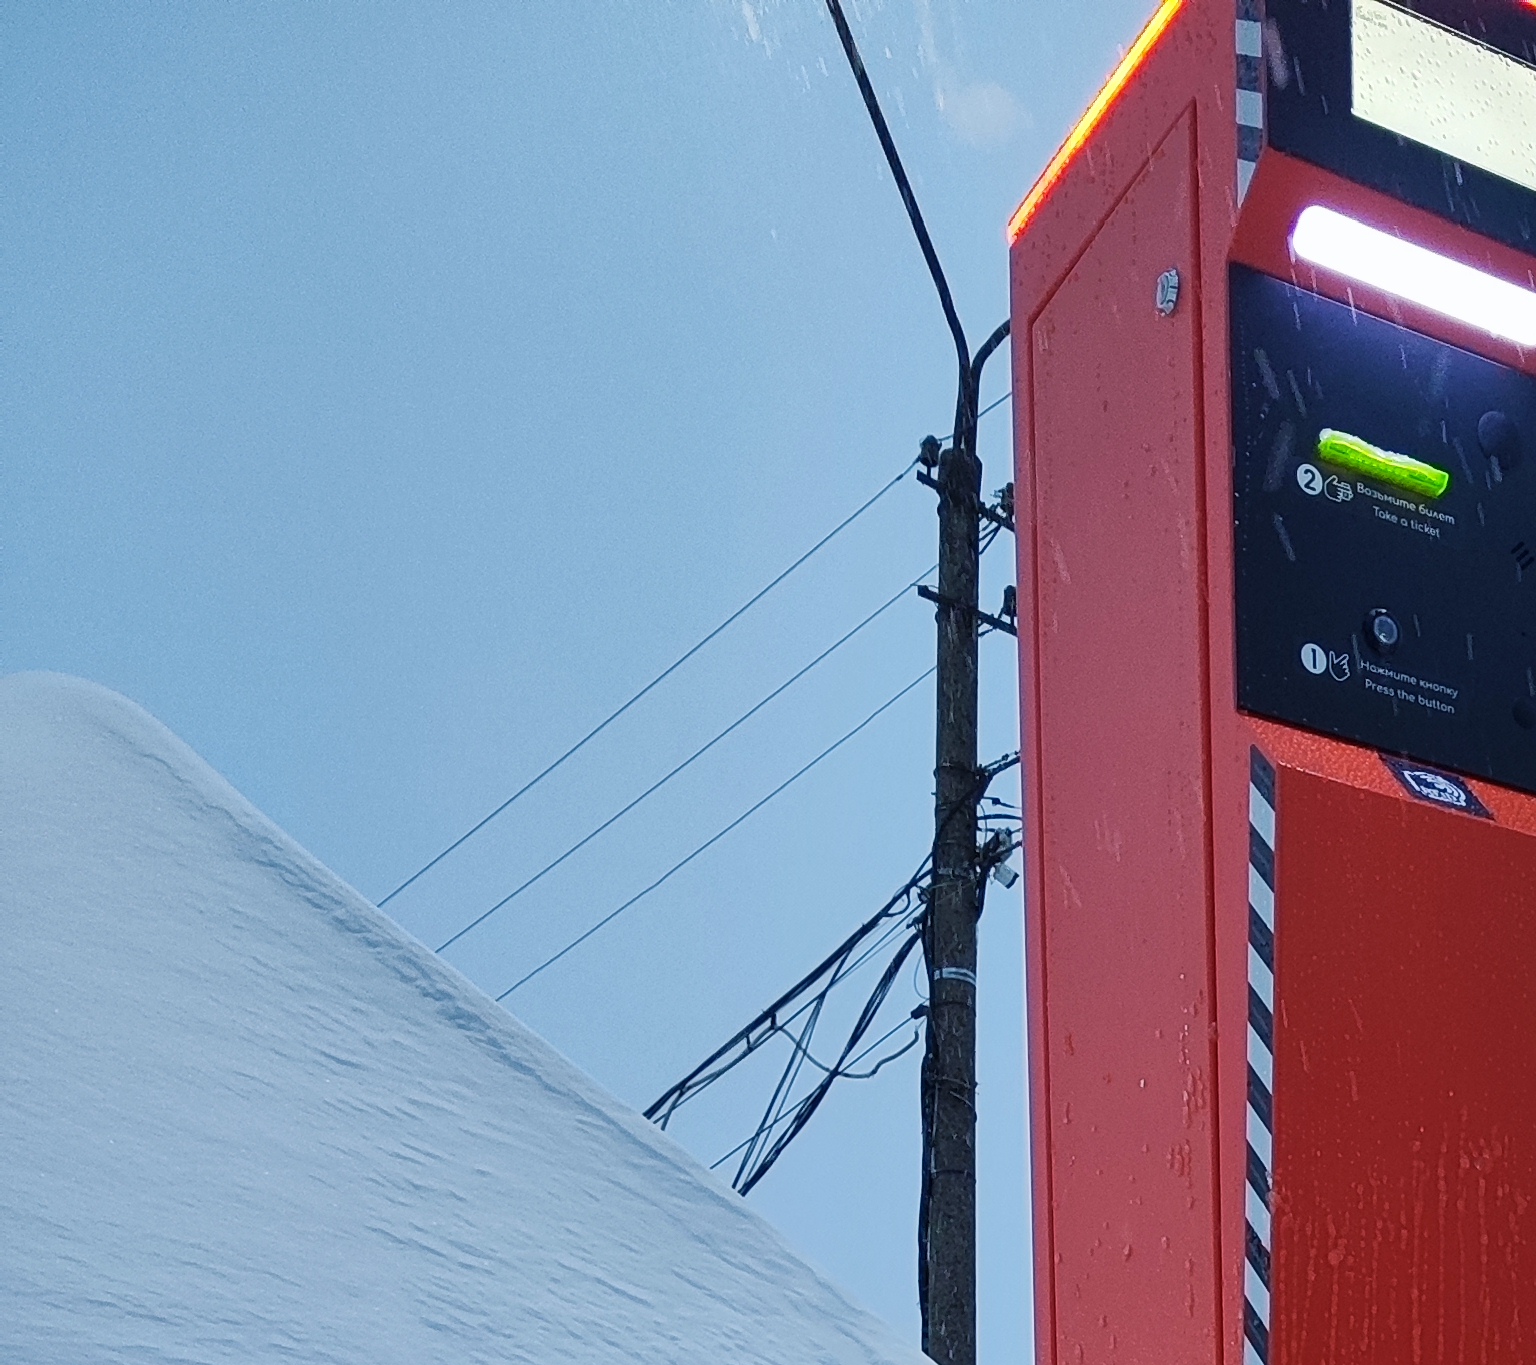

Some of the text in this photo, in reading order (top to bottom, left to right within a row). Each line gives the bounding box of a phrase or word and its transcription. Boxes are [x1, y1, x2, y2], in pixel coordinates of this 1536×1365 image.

[1303, 468, 1317, 492] 2
[1356, 481, 1455, 526] Возьмите билет
[1372, 505, 1441, 538] Take a ticket
[1360, 659, 1459, 700] Нажмите кнопку
[1365, 678, 1456, 714] Press the button
